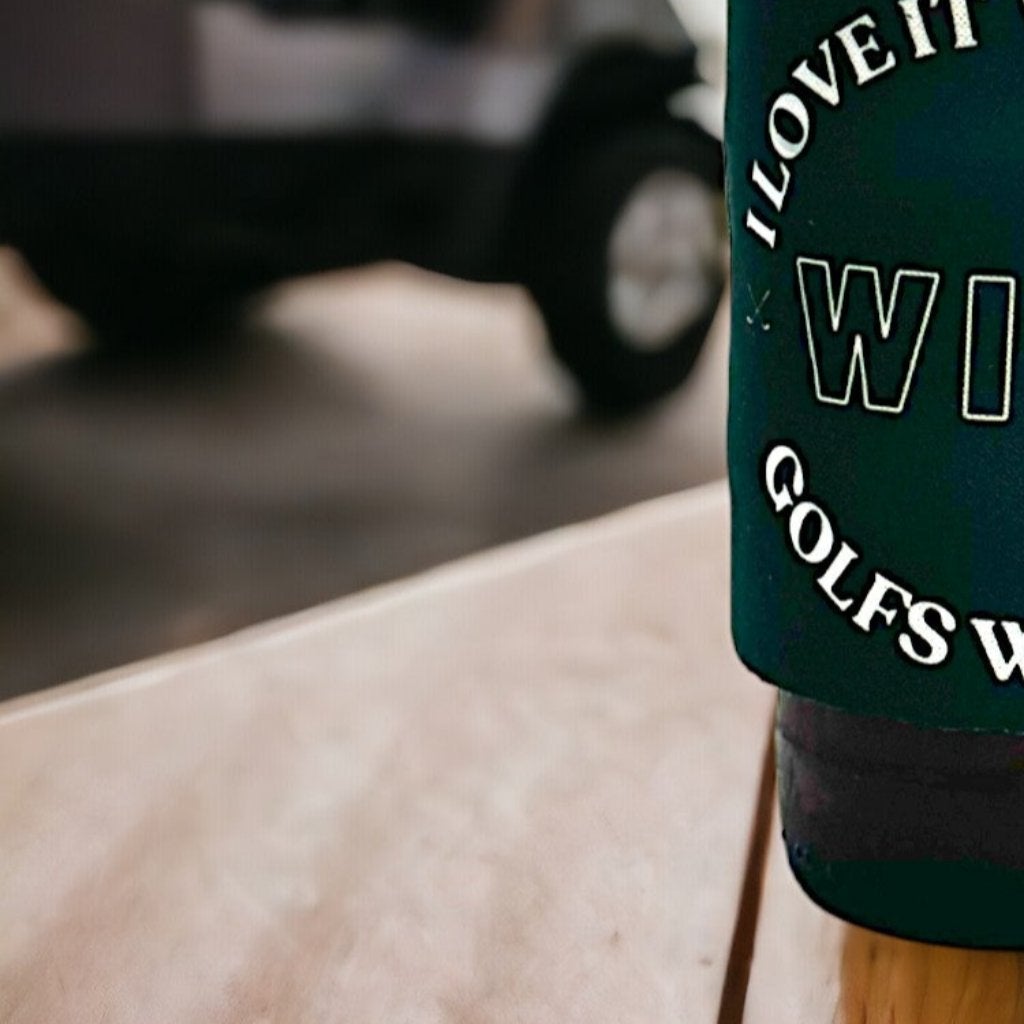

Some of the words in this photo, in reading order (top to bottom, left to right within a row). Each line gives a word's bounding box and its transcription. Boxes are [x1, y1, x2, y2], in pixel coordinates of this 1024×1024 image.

[751, 14, 896, 214] LOVE
[746, 211, 776, 248] I
[765, 444, 957, 666] GOLFS
